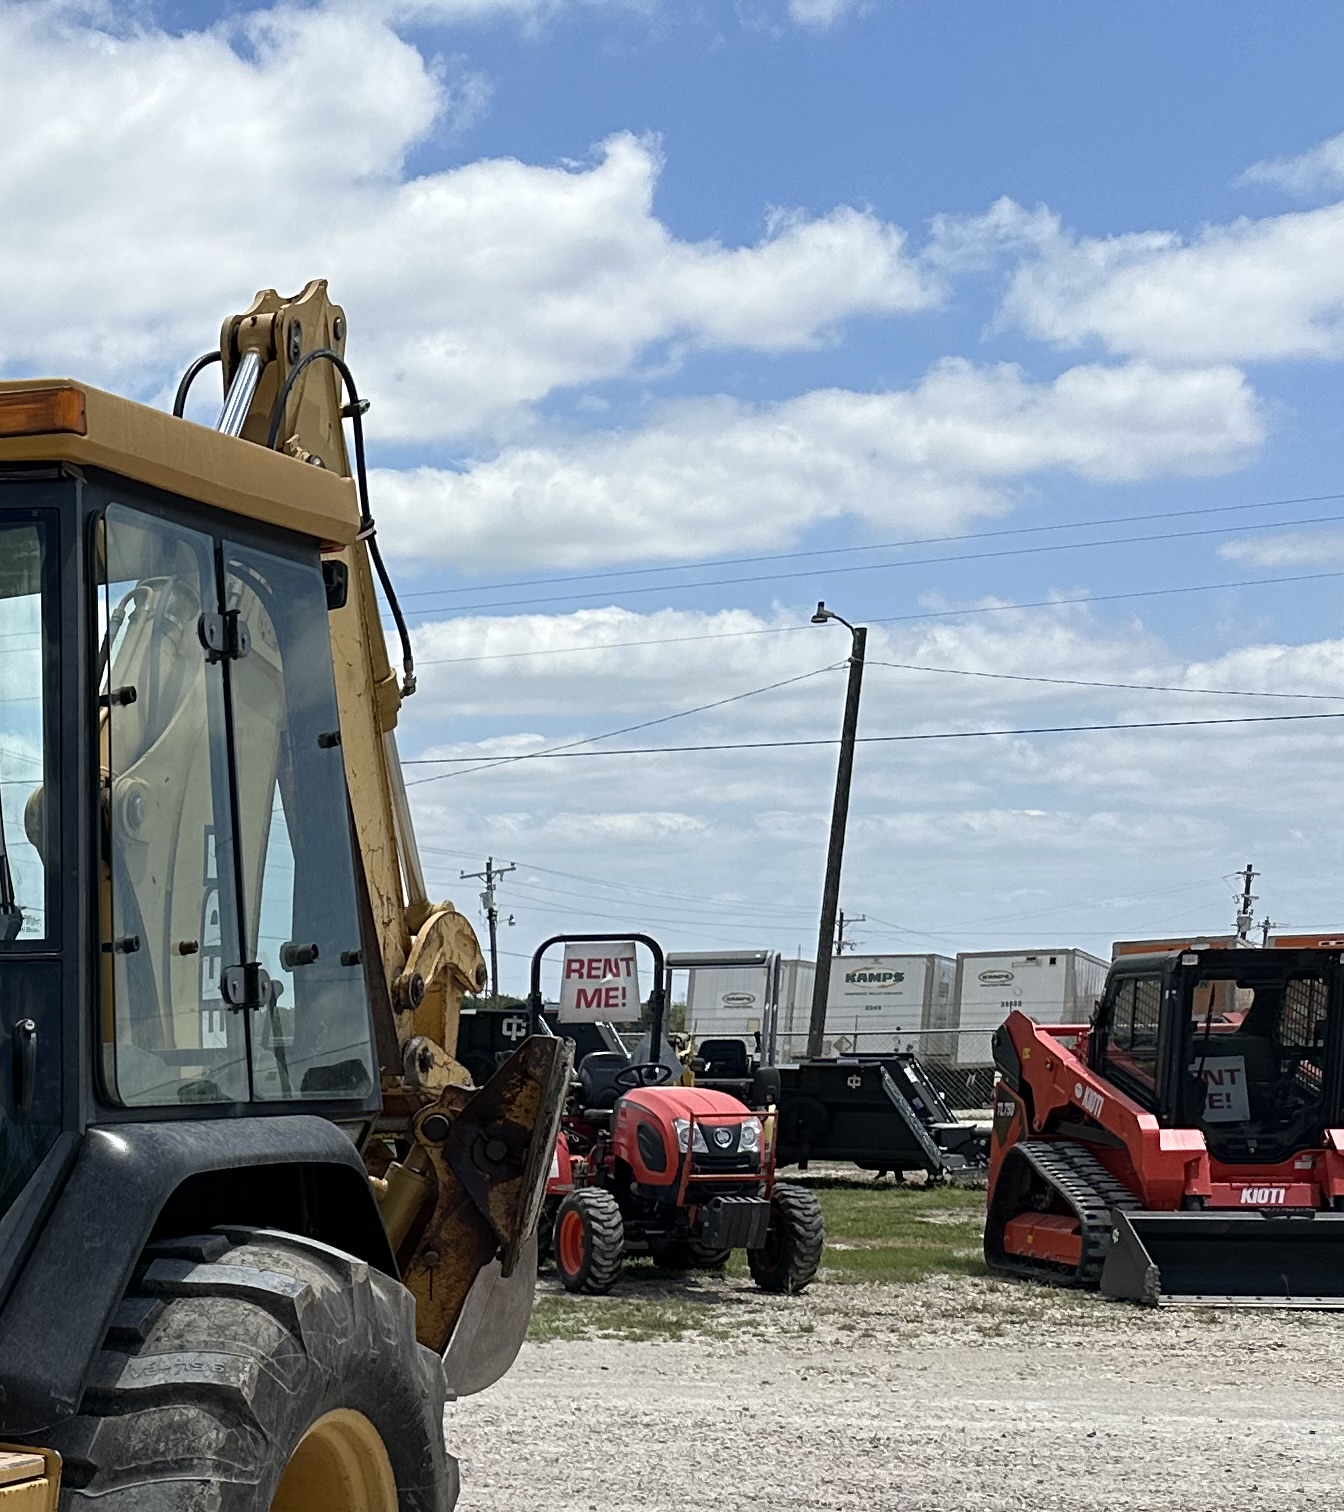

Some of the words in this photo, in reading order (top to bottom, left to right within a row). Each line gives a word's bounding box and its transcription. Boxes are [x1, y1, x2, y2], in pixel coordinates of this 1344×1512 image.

[565, 957, 634, 979] RENT
[845, 971, 905, 983] KAMPS
[575, 986, 626, 1009] ME!
[1203, 1068, 1241, 1085] NT
[1081, 1086, 1105, 1118] KIOTI
[1208, 1092, 1232, 1109] E!
[1240, 1187, 1285, 1204] KIOTI
